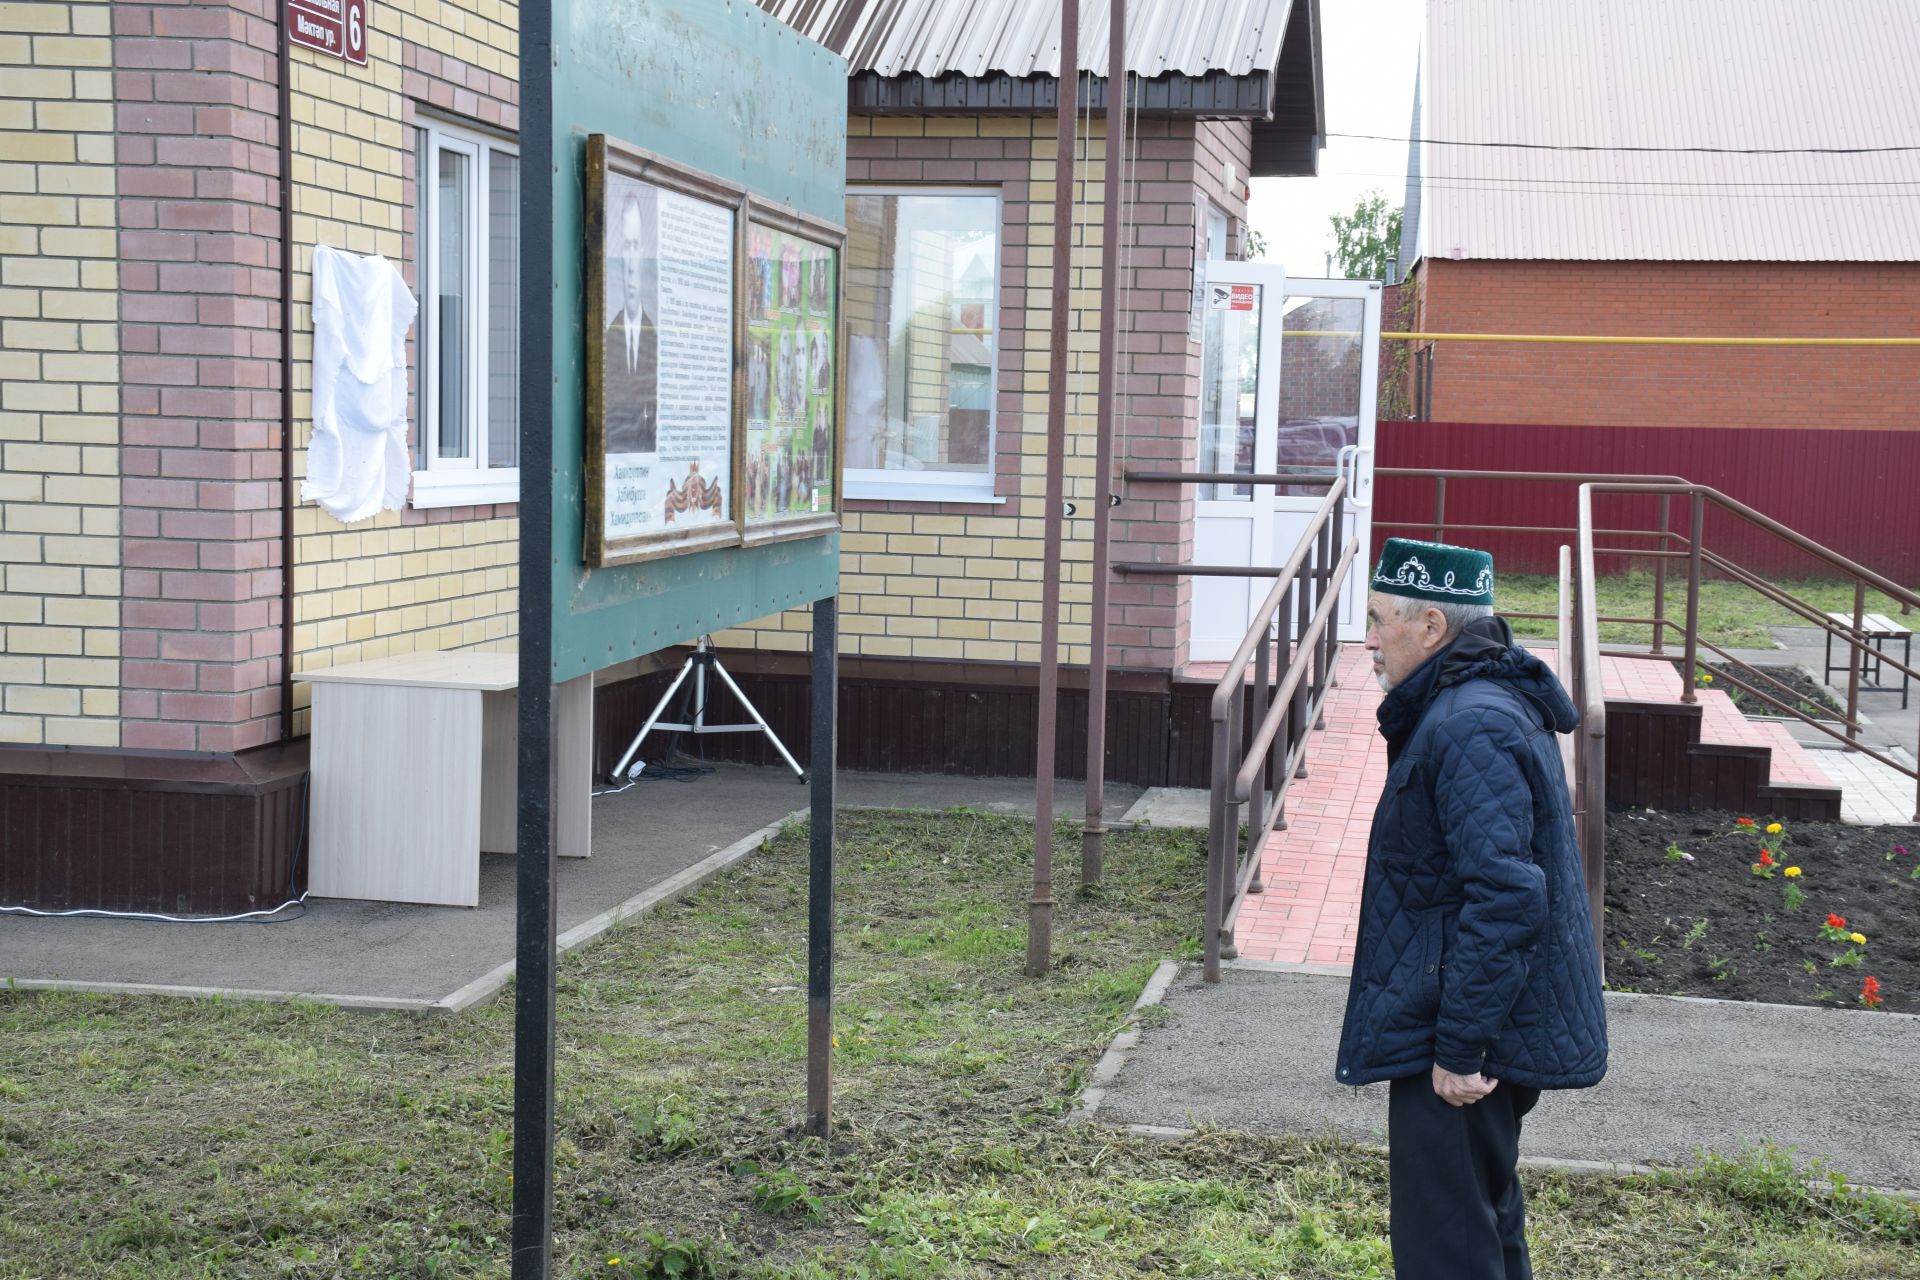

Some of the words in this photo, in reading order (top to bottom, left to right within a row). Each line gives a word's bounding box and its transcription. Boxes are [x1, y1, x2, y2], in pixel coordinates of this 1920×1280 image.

[304, 0, 339, 13] ольная
[297, 14, 325, 40] Мәктәп
[325, 28, 336, 47] ур.
[350, 5, 361, 51] 6
